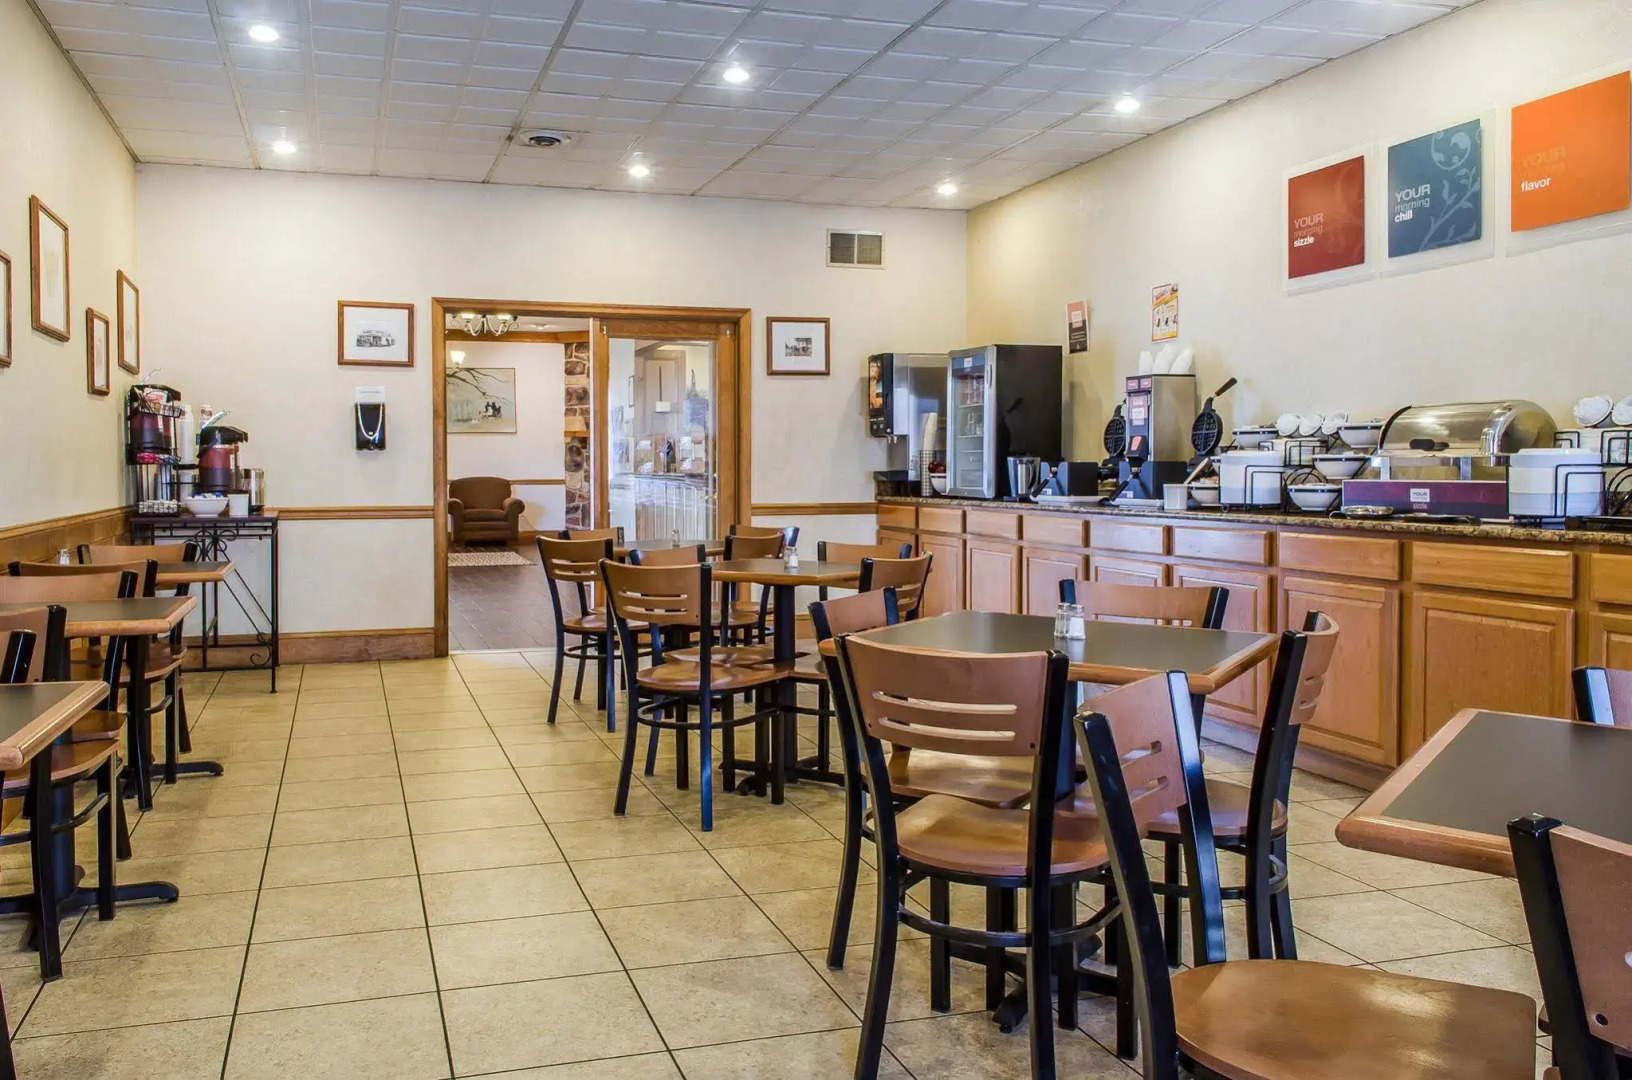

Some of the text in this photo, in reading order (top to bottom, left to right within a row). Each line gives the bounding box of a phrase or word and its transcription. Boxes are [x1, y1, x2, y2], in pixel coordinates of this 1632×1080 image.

[1520, 177, 1552, 192] flavor
[1394, 183, 1431, 202] YOUR
[1394, 197, 1430, 213] morning
[1293, 212, 1324, 229] YOUR
[1394, 209, 1413, 223] chill
[1293, 235, 1315, 248] sizzle
